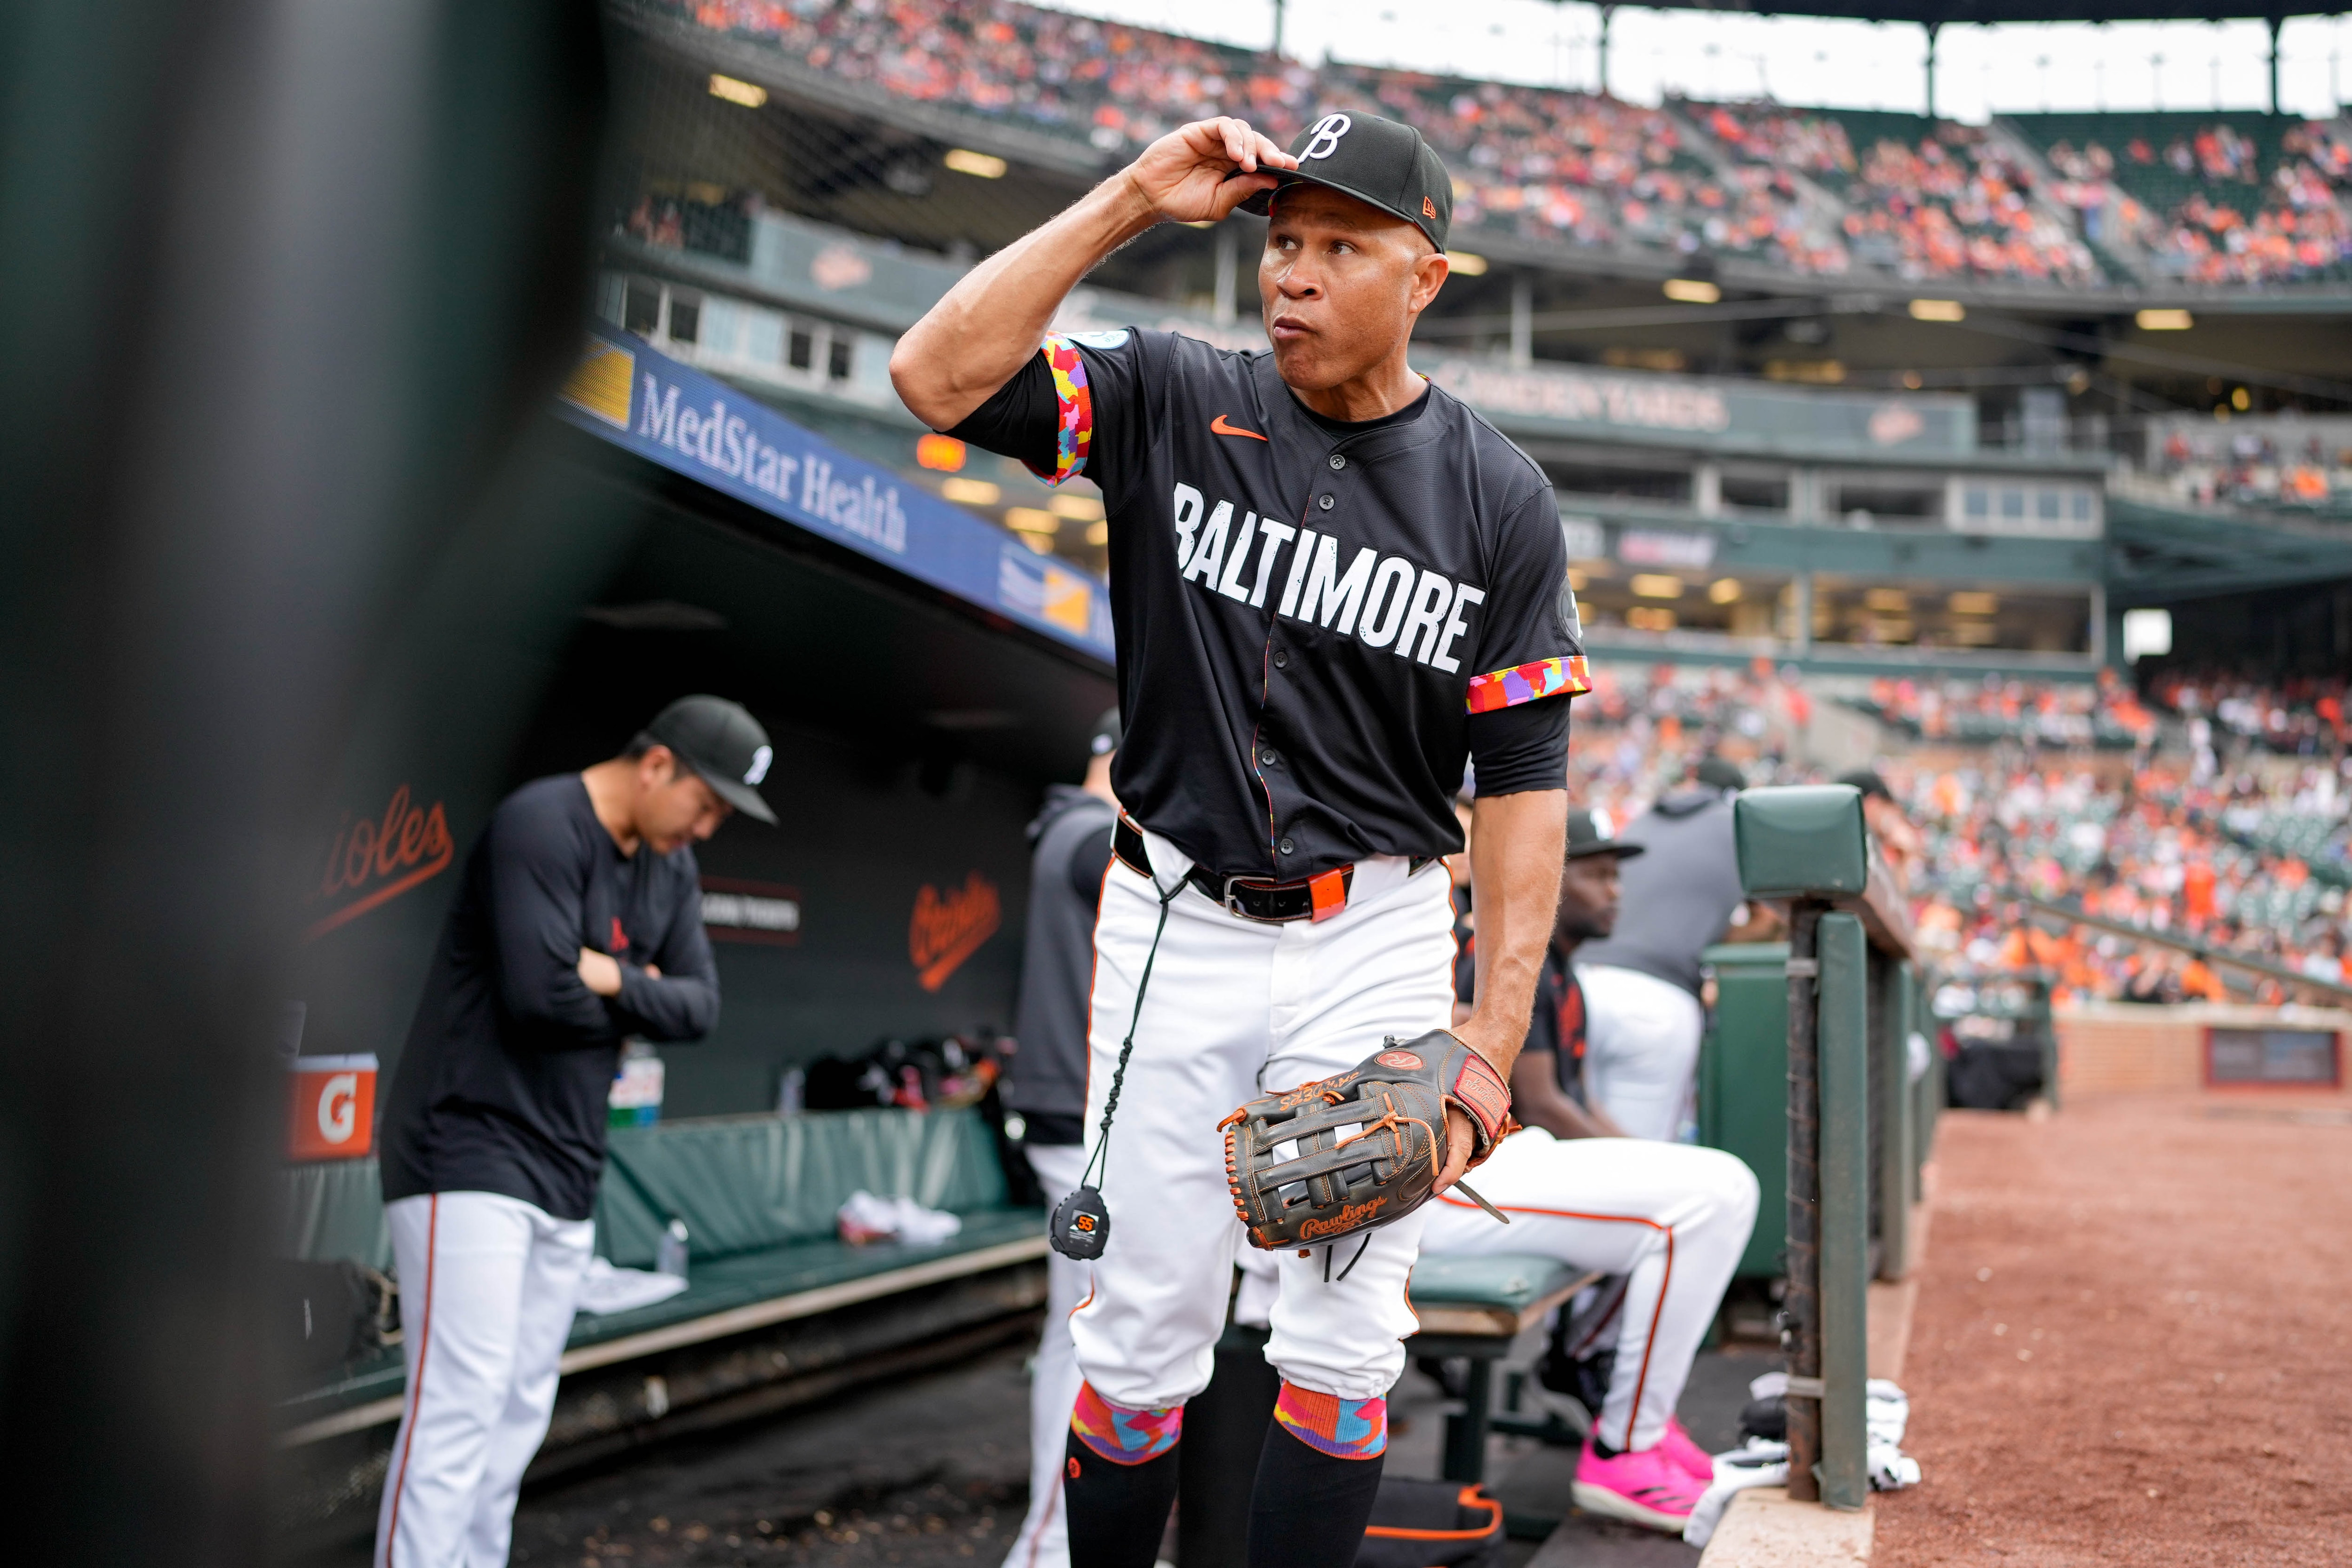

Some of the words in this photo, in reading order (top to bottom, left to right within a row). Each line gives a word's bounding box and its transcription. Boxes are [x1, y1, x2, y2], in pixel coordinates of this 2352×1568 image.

[1297, 113, 1351, 164] B
[637, 372, 798, 501] MedStar
[800, 454, 907, 554] Health
[1173, 481, 1486, 674] BALTIMORE
[314, 783, 454, 906] ioles
[318, 1072, 357, 1145] G
[1465, 1078, 1503, 1118] Rawlings
[1078, 1216, 1094, 1231] 55
[1300, 1195, 1388, 1240] Rawlings
